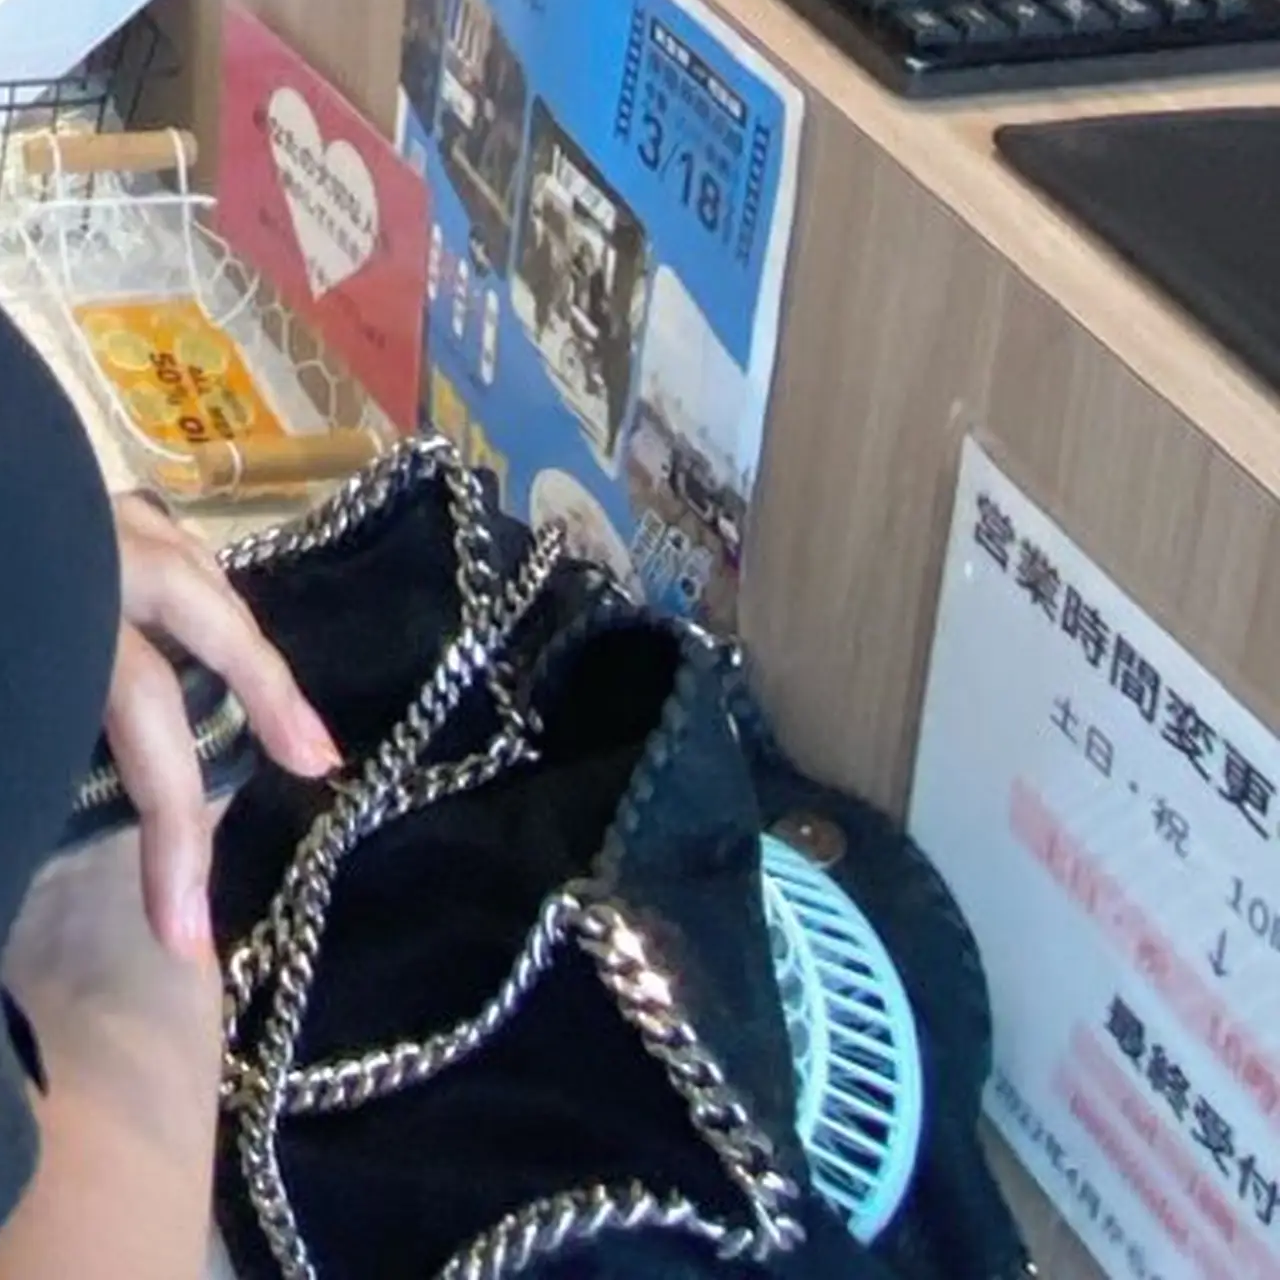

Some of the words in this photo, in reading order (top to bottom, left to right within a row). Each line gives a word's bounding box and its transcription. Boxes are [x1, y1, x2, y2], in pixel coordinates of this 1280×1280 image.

[973, 492, 1278, 842] 営業時間変更
